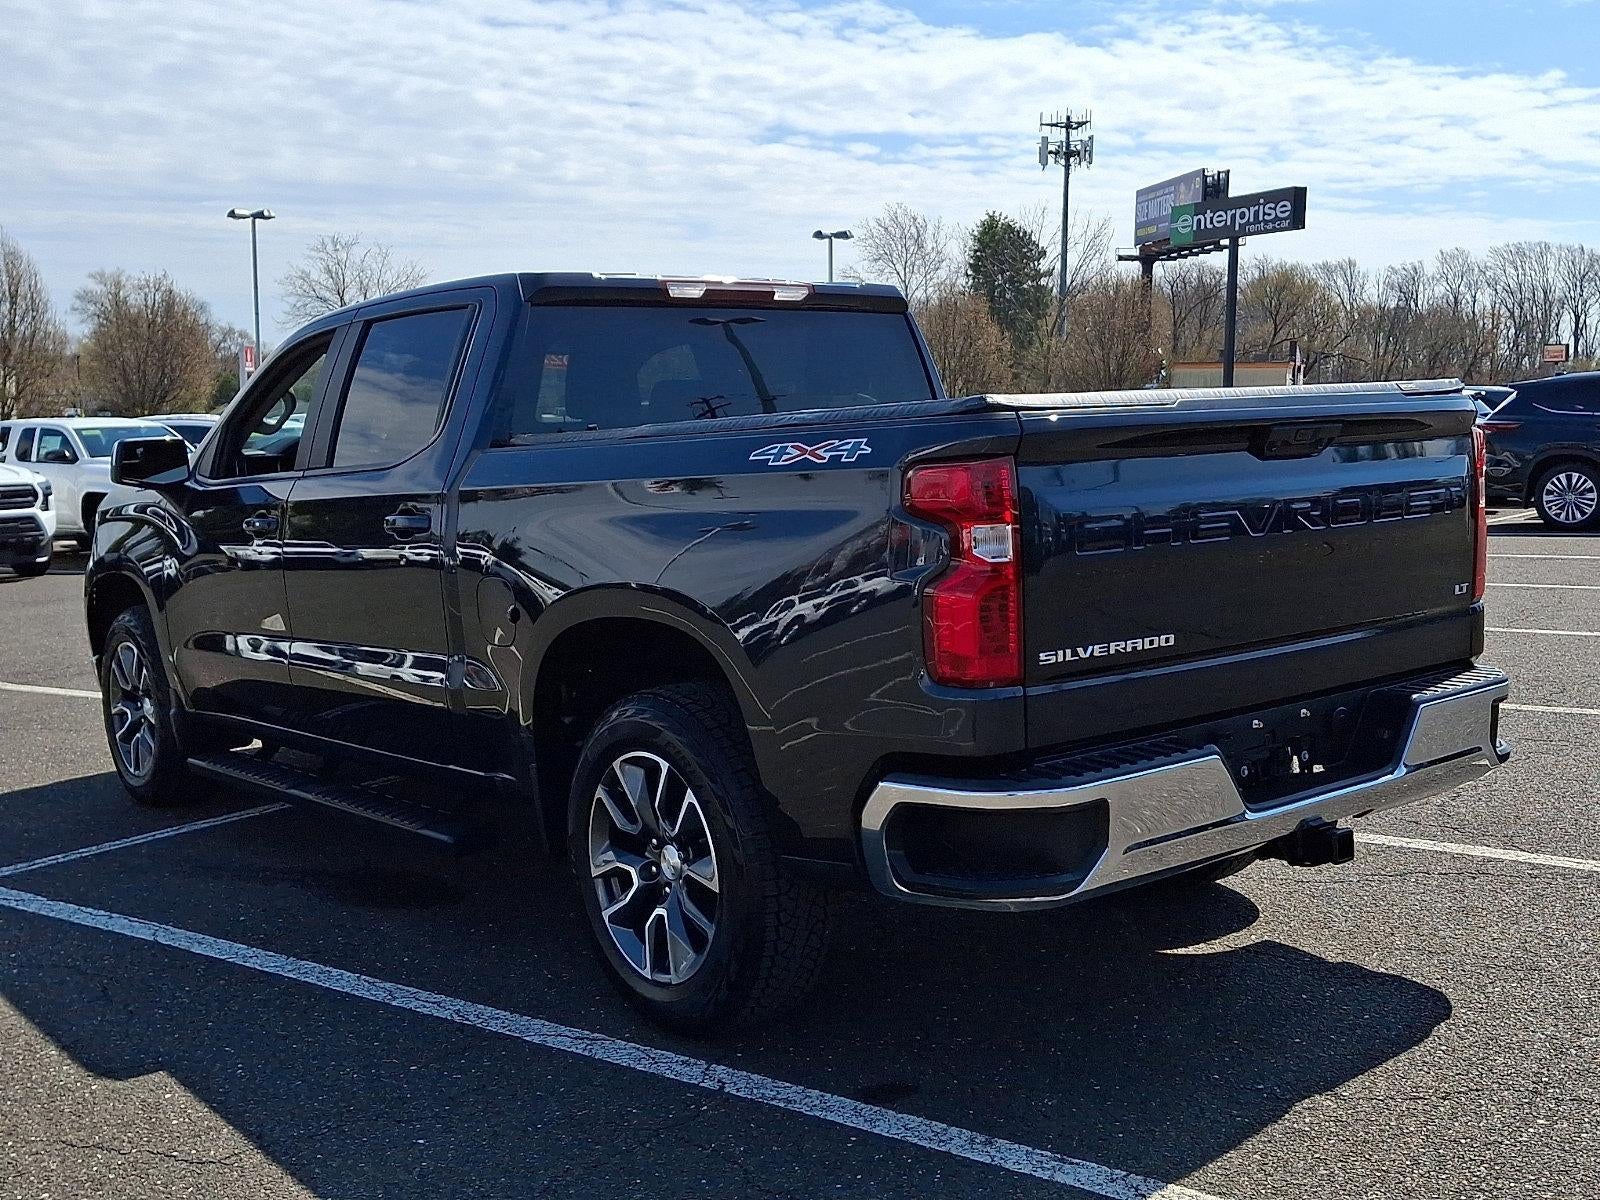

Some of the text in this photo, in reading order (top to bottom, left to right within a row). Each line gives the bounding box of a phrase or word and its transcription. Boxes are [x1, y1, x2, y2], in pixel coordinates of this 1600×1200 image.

[1171, 198, 1292, 233] enterprise
[1245, 218, 1291, 233] rent-a-car
[1074, 486, 1464, 556] CHEVROLET
[1454, 582, 1470, 596] LT
[1038, 633, 1176, 666] SILVERADO
